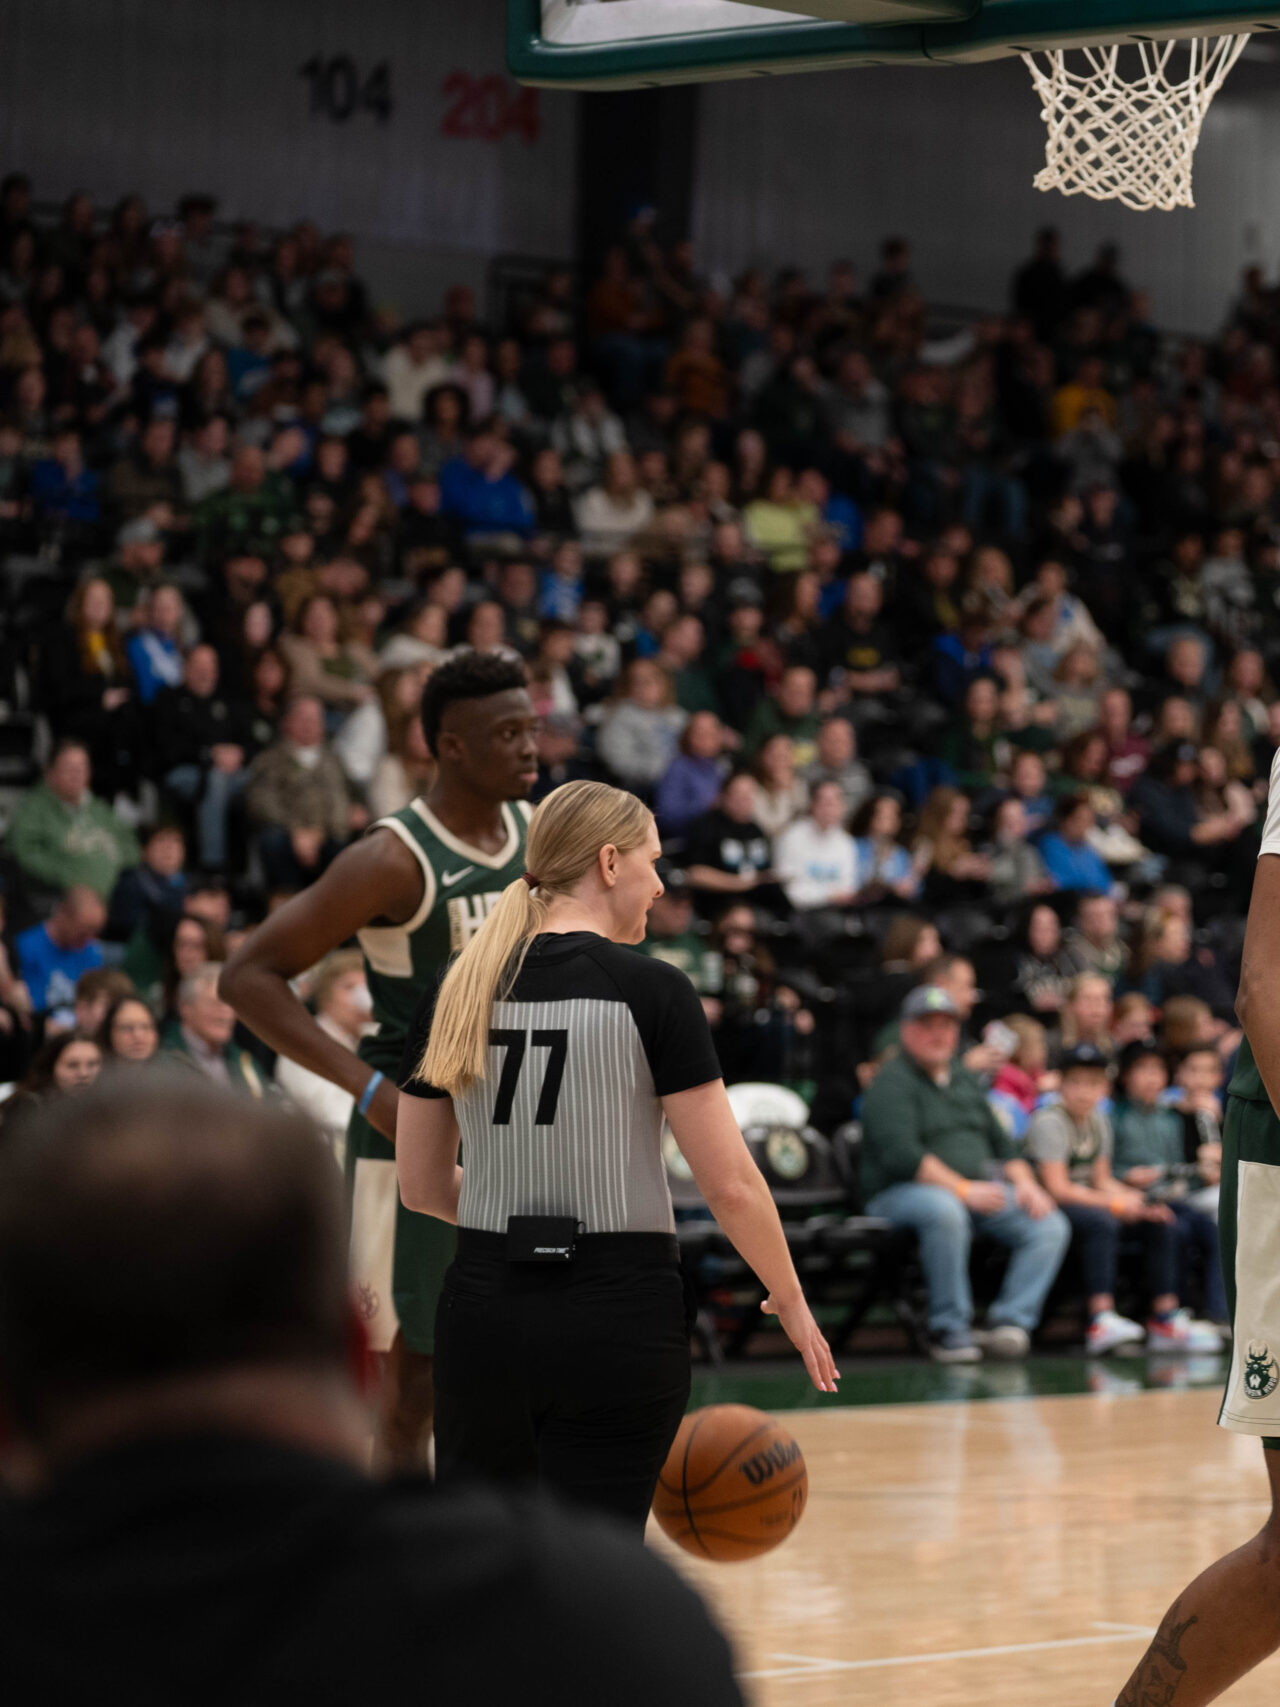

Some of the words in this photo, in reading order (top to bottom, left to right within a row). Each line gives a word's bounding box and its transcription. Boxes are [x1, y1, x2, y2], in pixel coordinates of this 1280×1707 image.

[300, 53, 391, 123] 104
[443, 70, 540, 145] 204
[488, 1029, 569, 1126] 77
